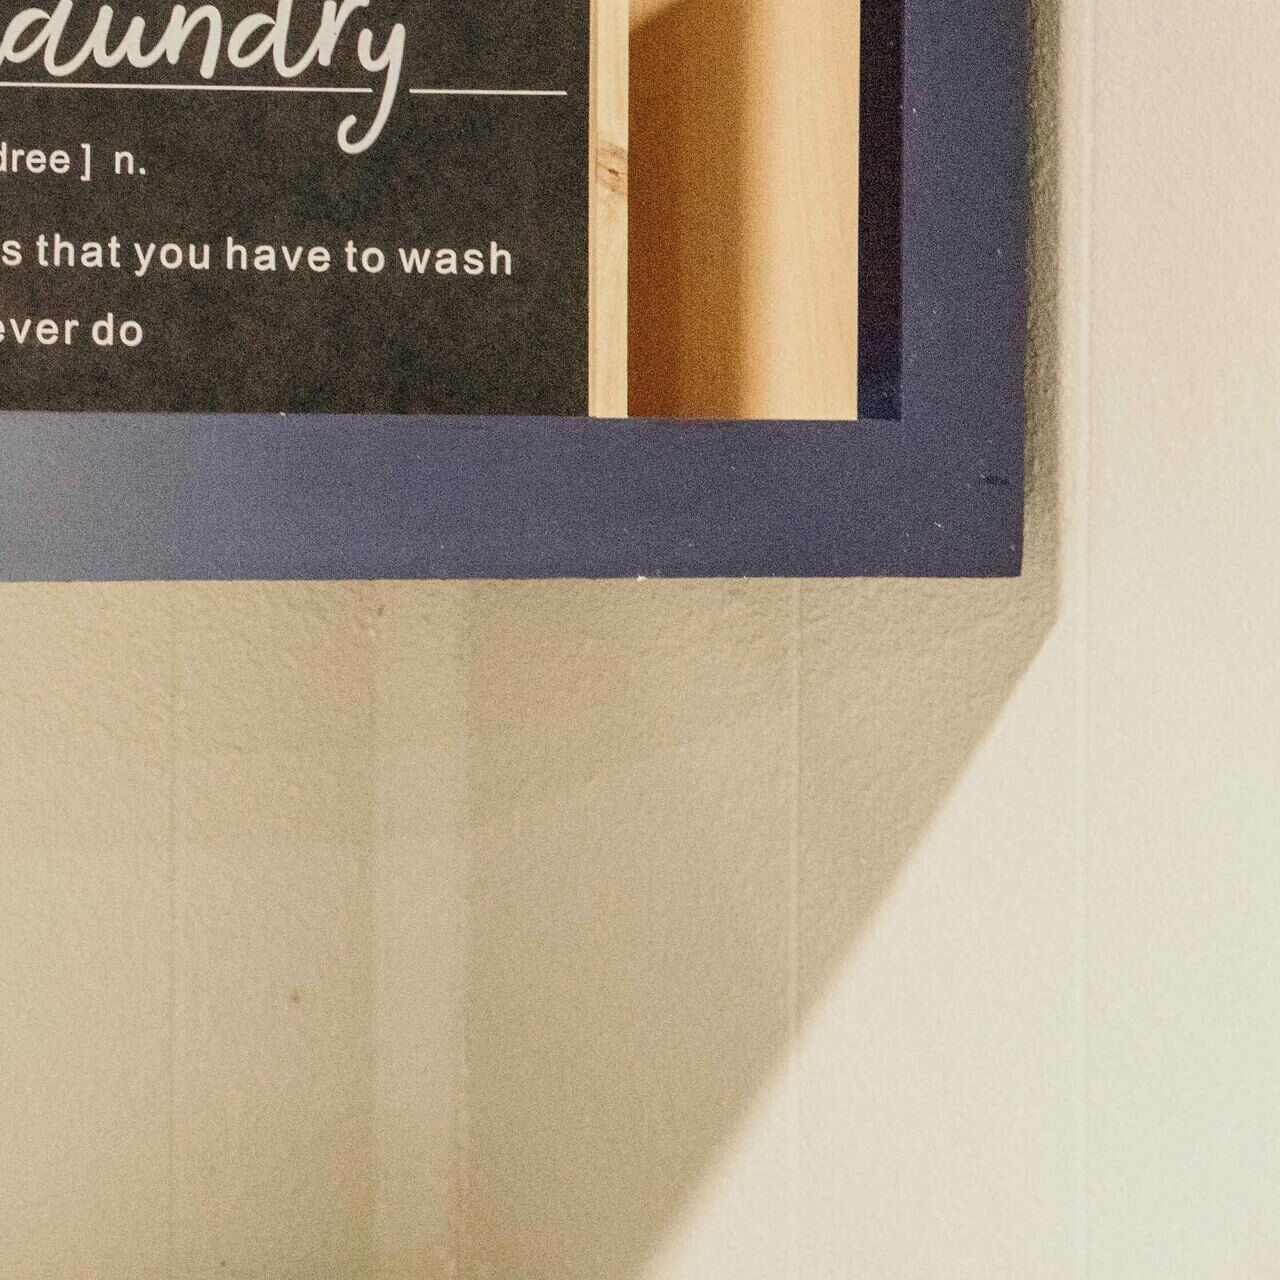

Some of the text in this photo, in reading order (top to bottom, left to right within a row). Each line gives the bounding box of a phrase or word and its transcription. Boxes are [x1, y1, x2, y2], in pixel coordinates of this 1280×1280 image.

[114, 150, 146, 175] n.
[36, 233, 121, 269] that
[134, 242, 210, 278] you
[226, 236, 331, 273] have
[345, 241, 386, 274] to
[398, 241, 512, 276] wash
[91, 312, 144, 347] do
